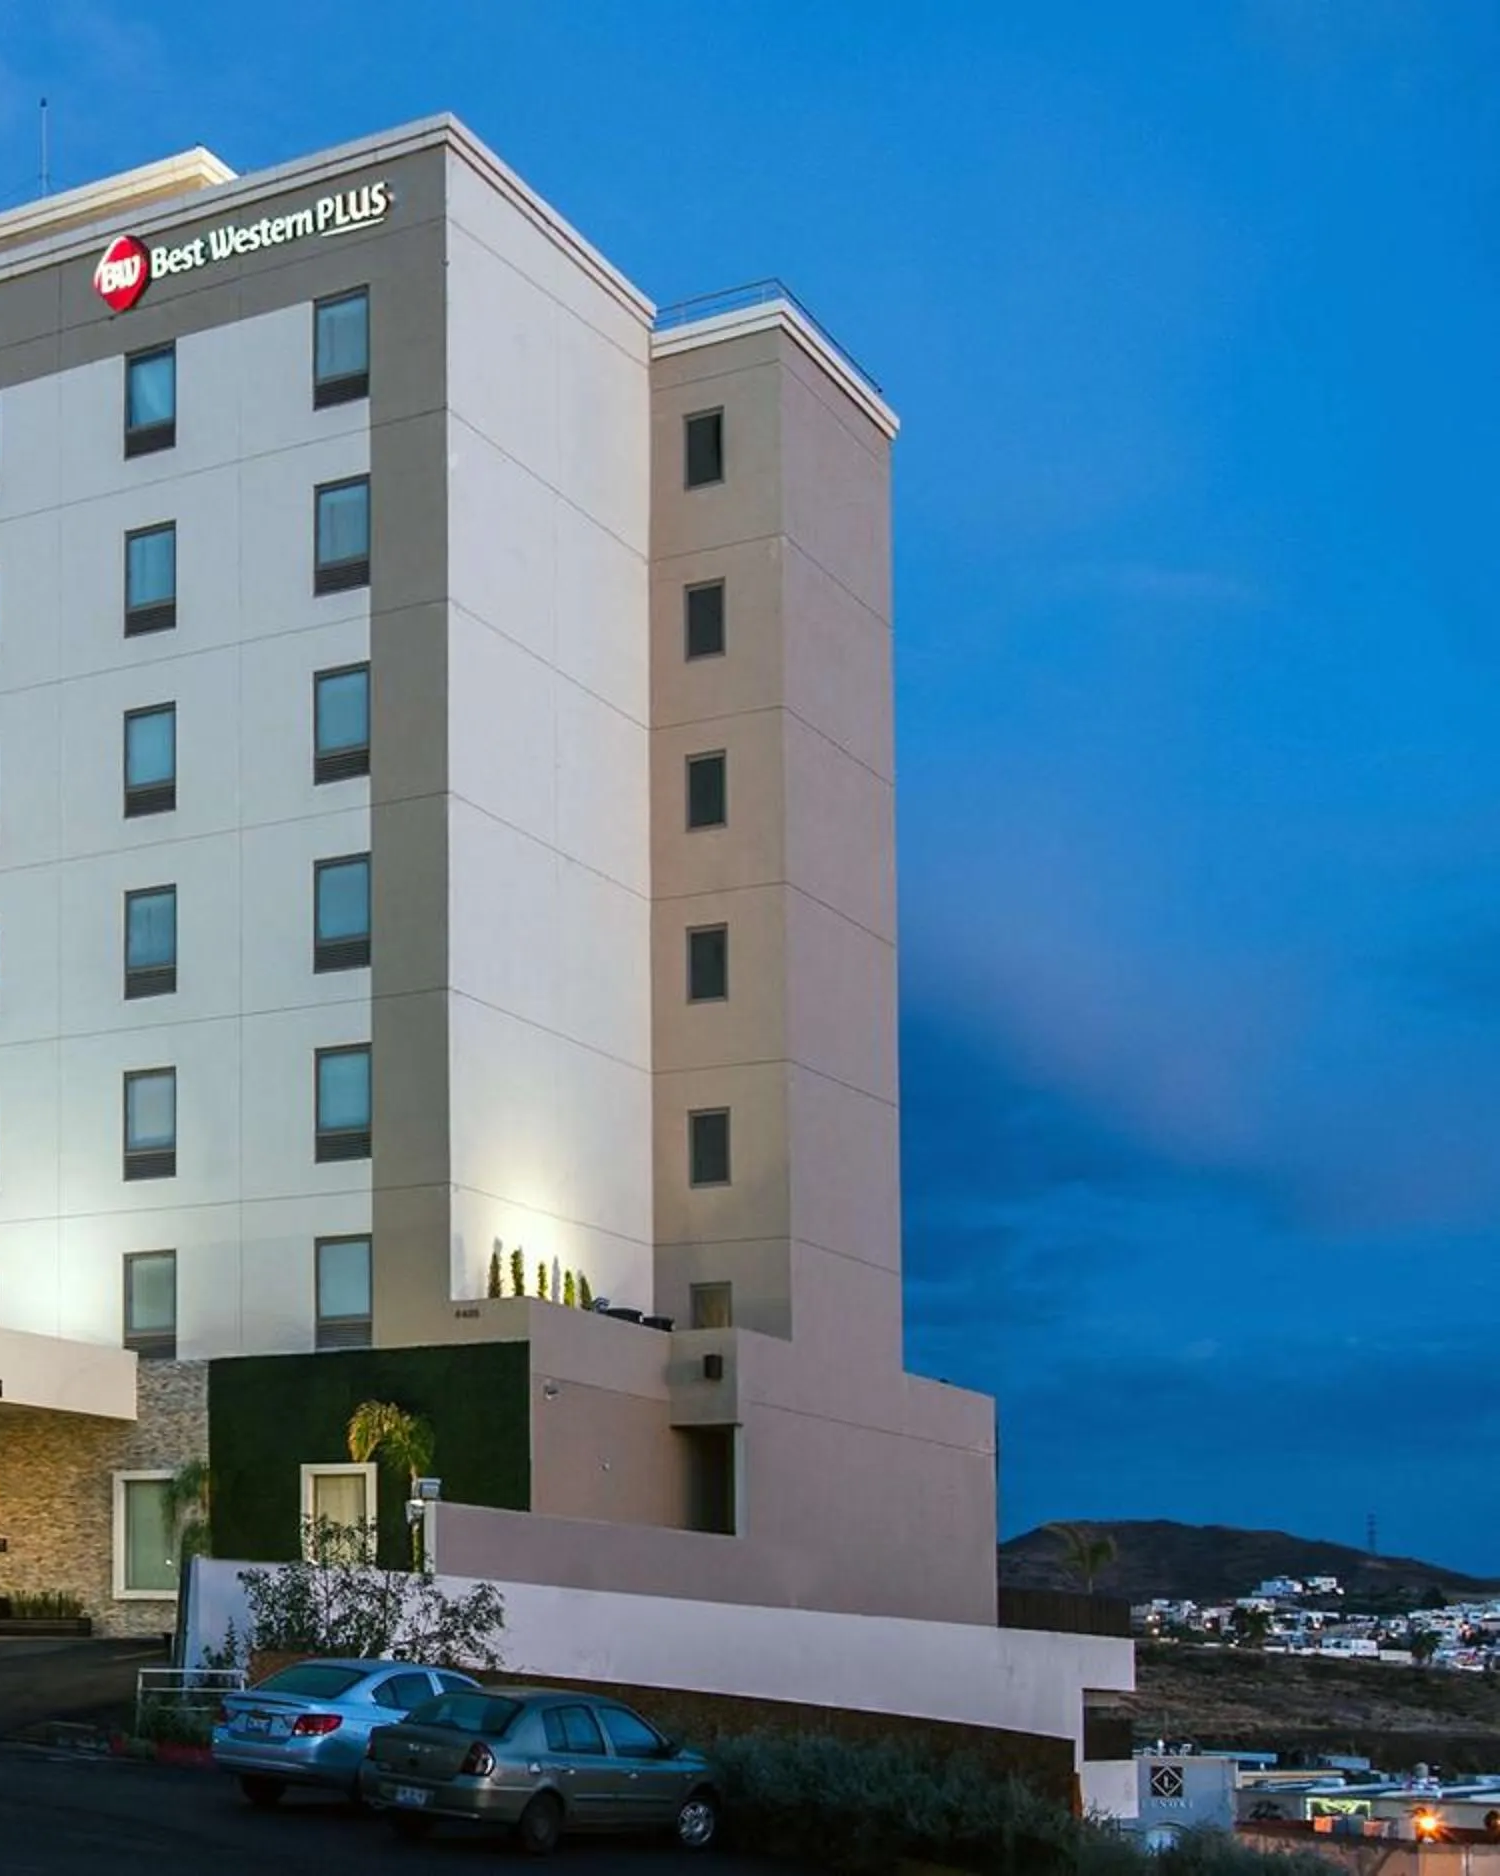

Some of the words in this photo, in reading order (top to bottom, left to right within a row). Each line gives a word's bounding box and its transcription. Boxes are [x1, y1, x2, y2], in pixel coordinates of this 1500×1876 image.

[150, 237, 205, 279] Best
[208, 208, 314, 261] Western
[316, 181, 388, 231] PLUS
[101, 252, 141, 294] BW
